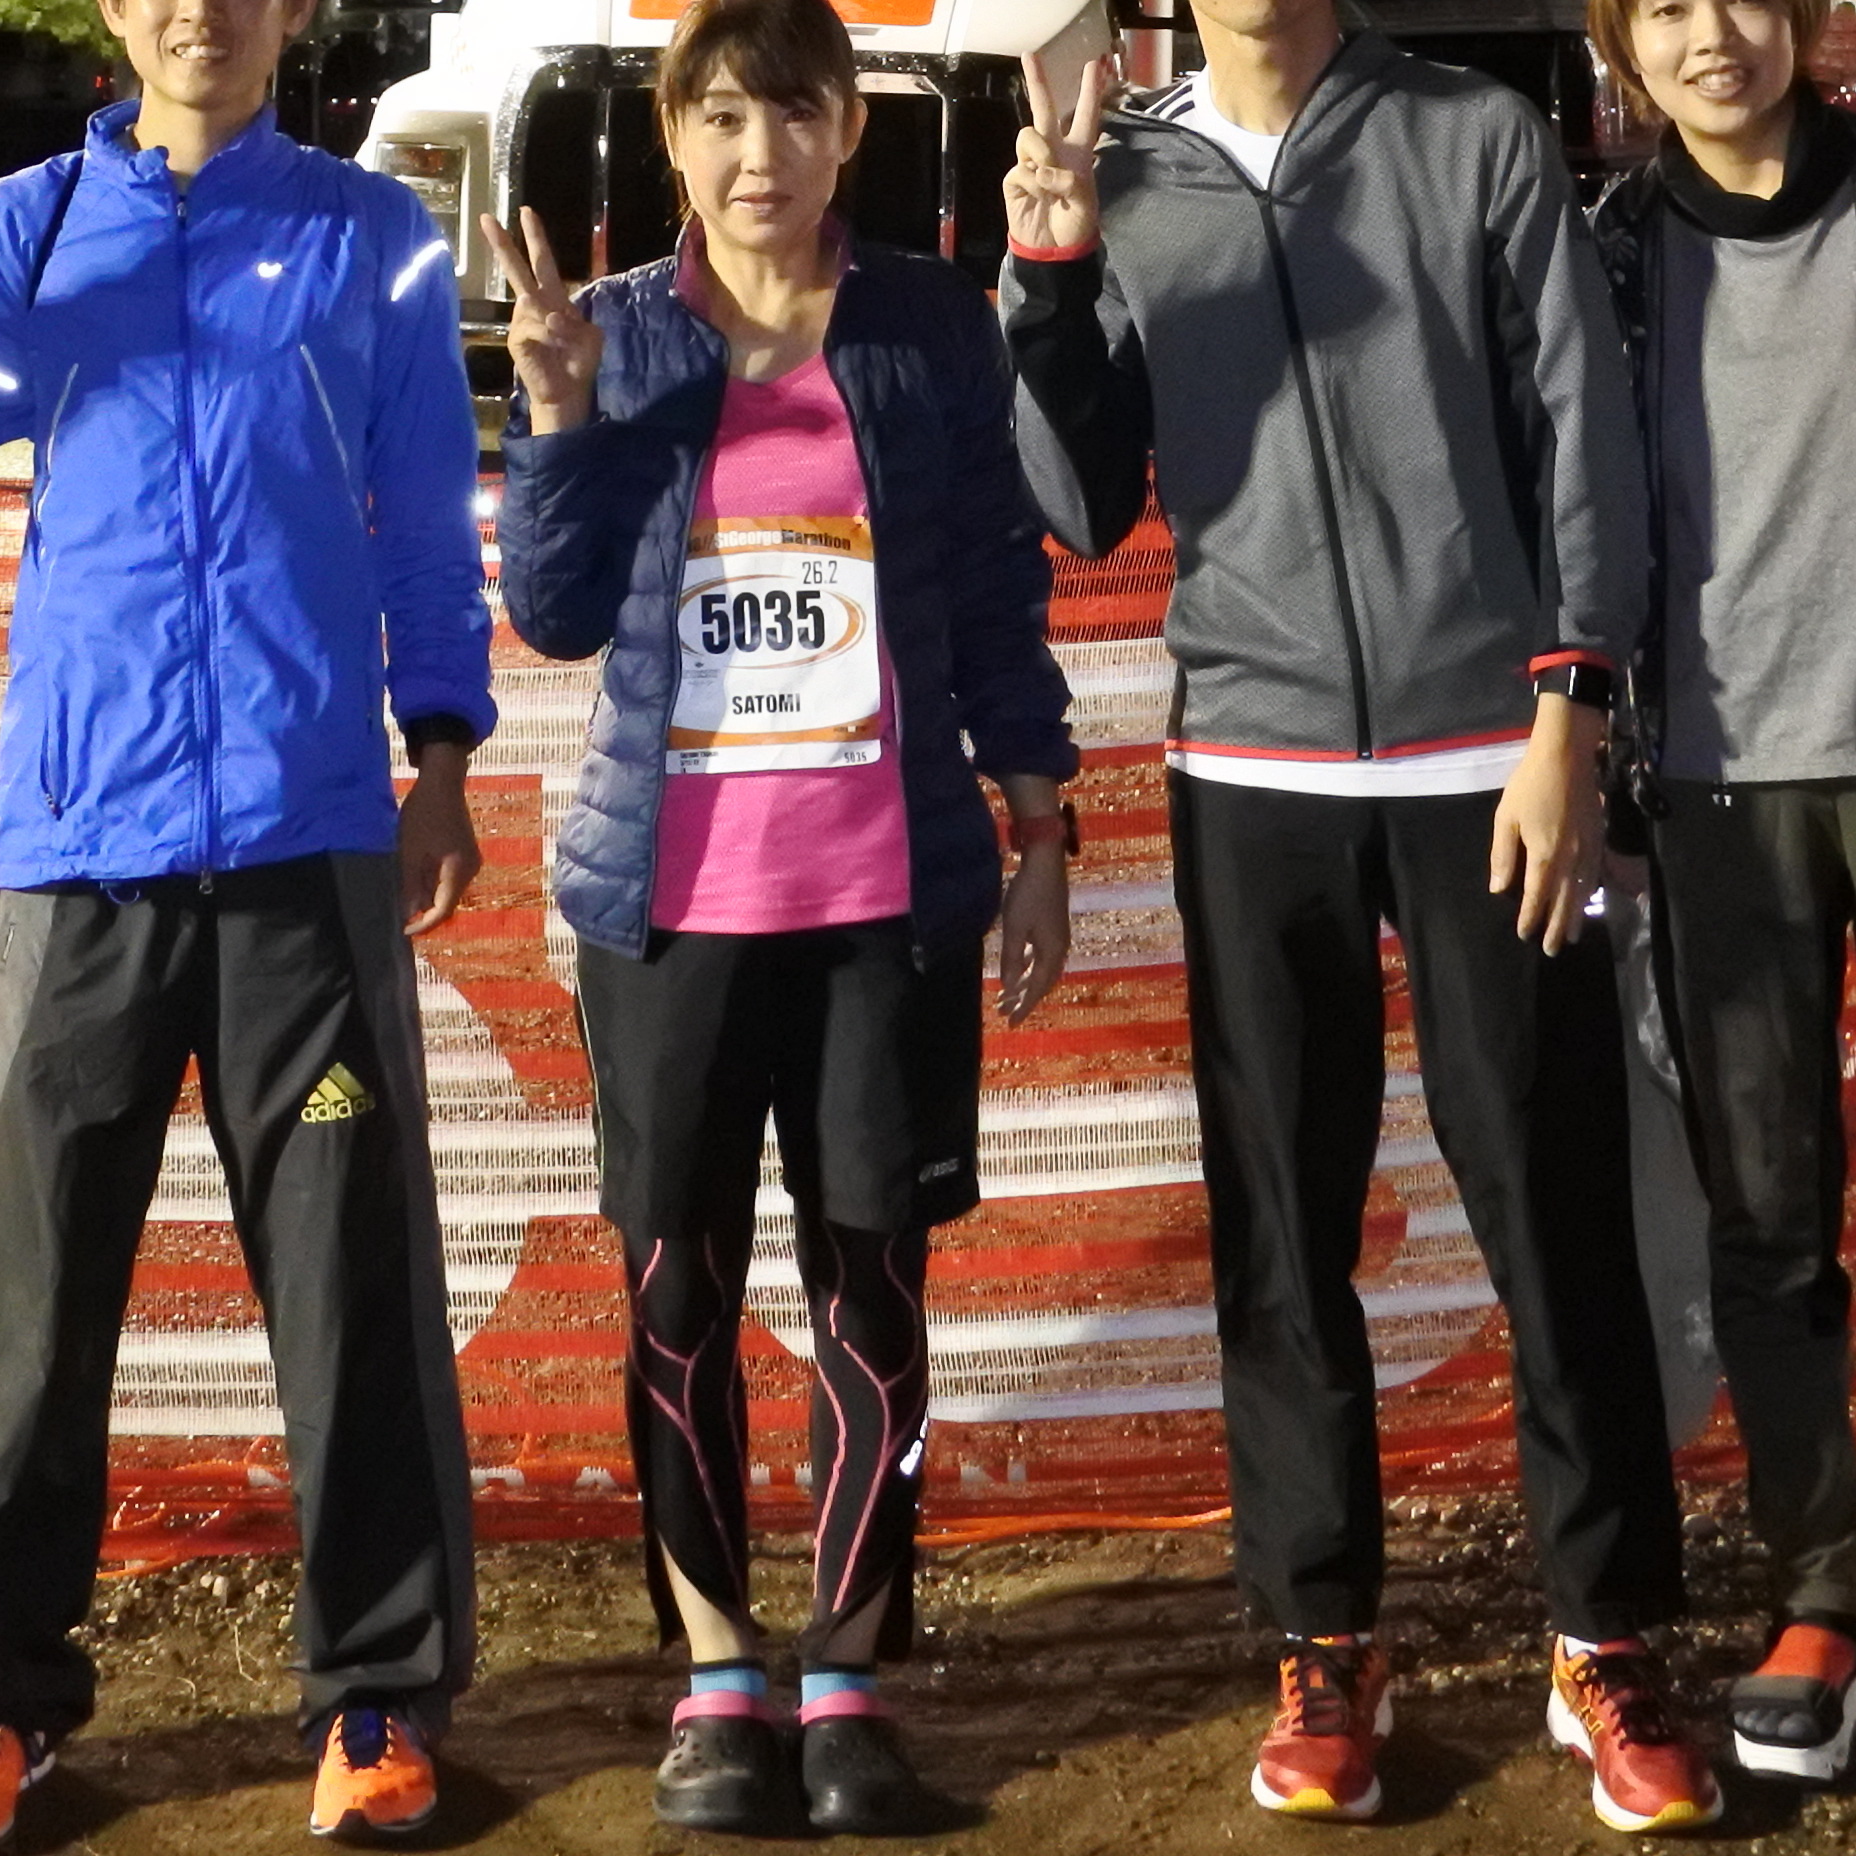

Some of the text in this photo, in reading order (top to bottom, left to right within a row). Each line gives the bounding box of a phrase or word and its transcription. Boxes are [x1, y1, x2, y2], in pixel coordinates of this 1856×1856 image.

[801, 560, 838, 585] 26.2
[700, 590, 826, 655] 5035
[732, 693, 802, 715] SATOMI
[844, 751, 867, 763] 5035
[300, 1092, 377, 1124] adidas
